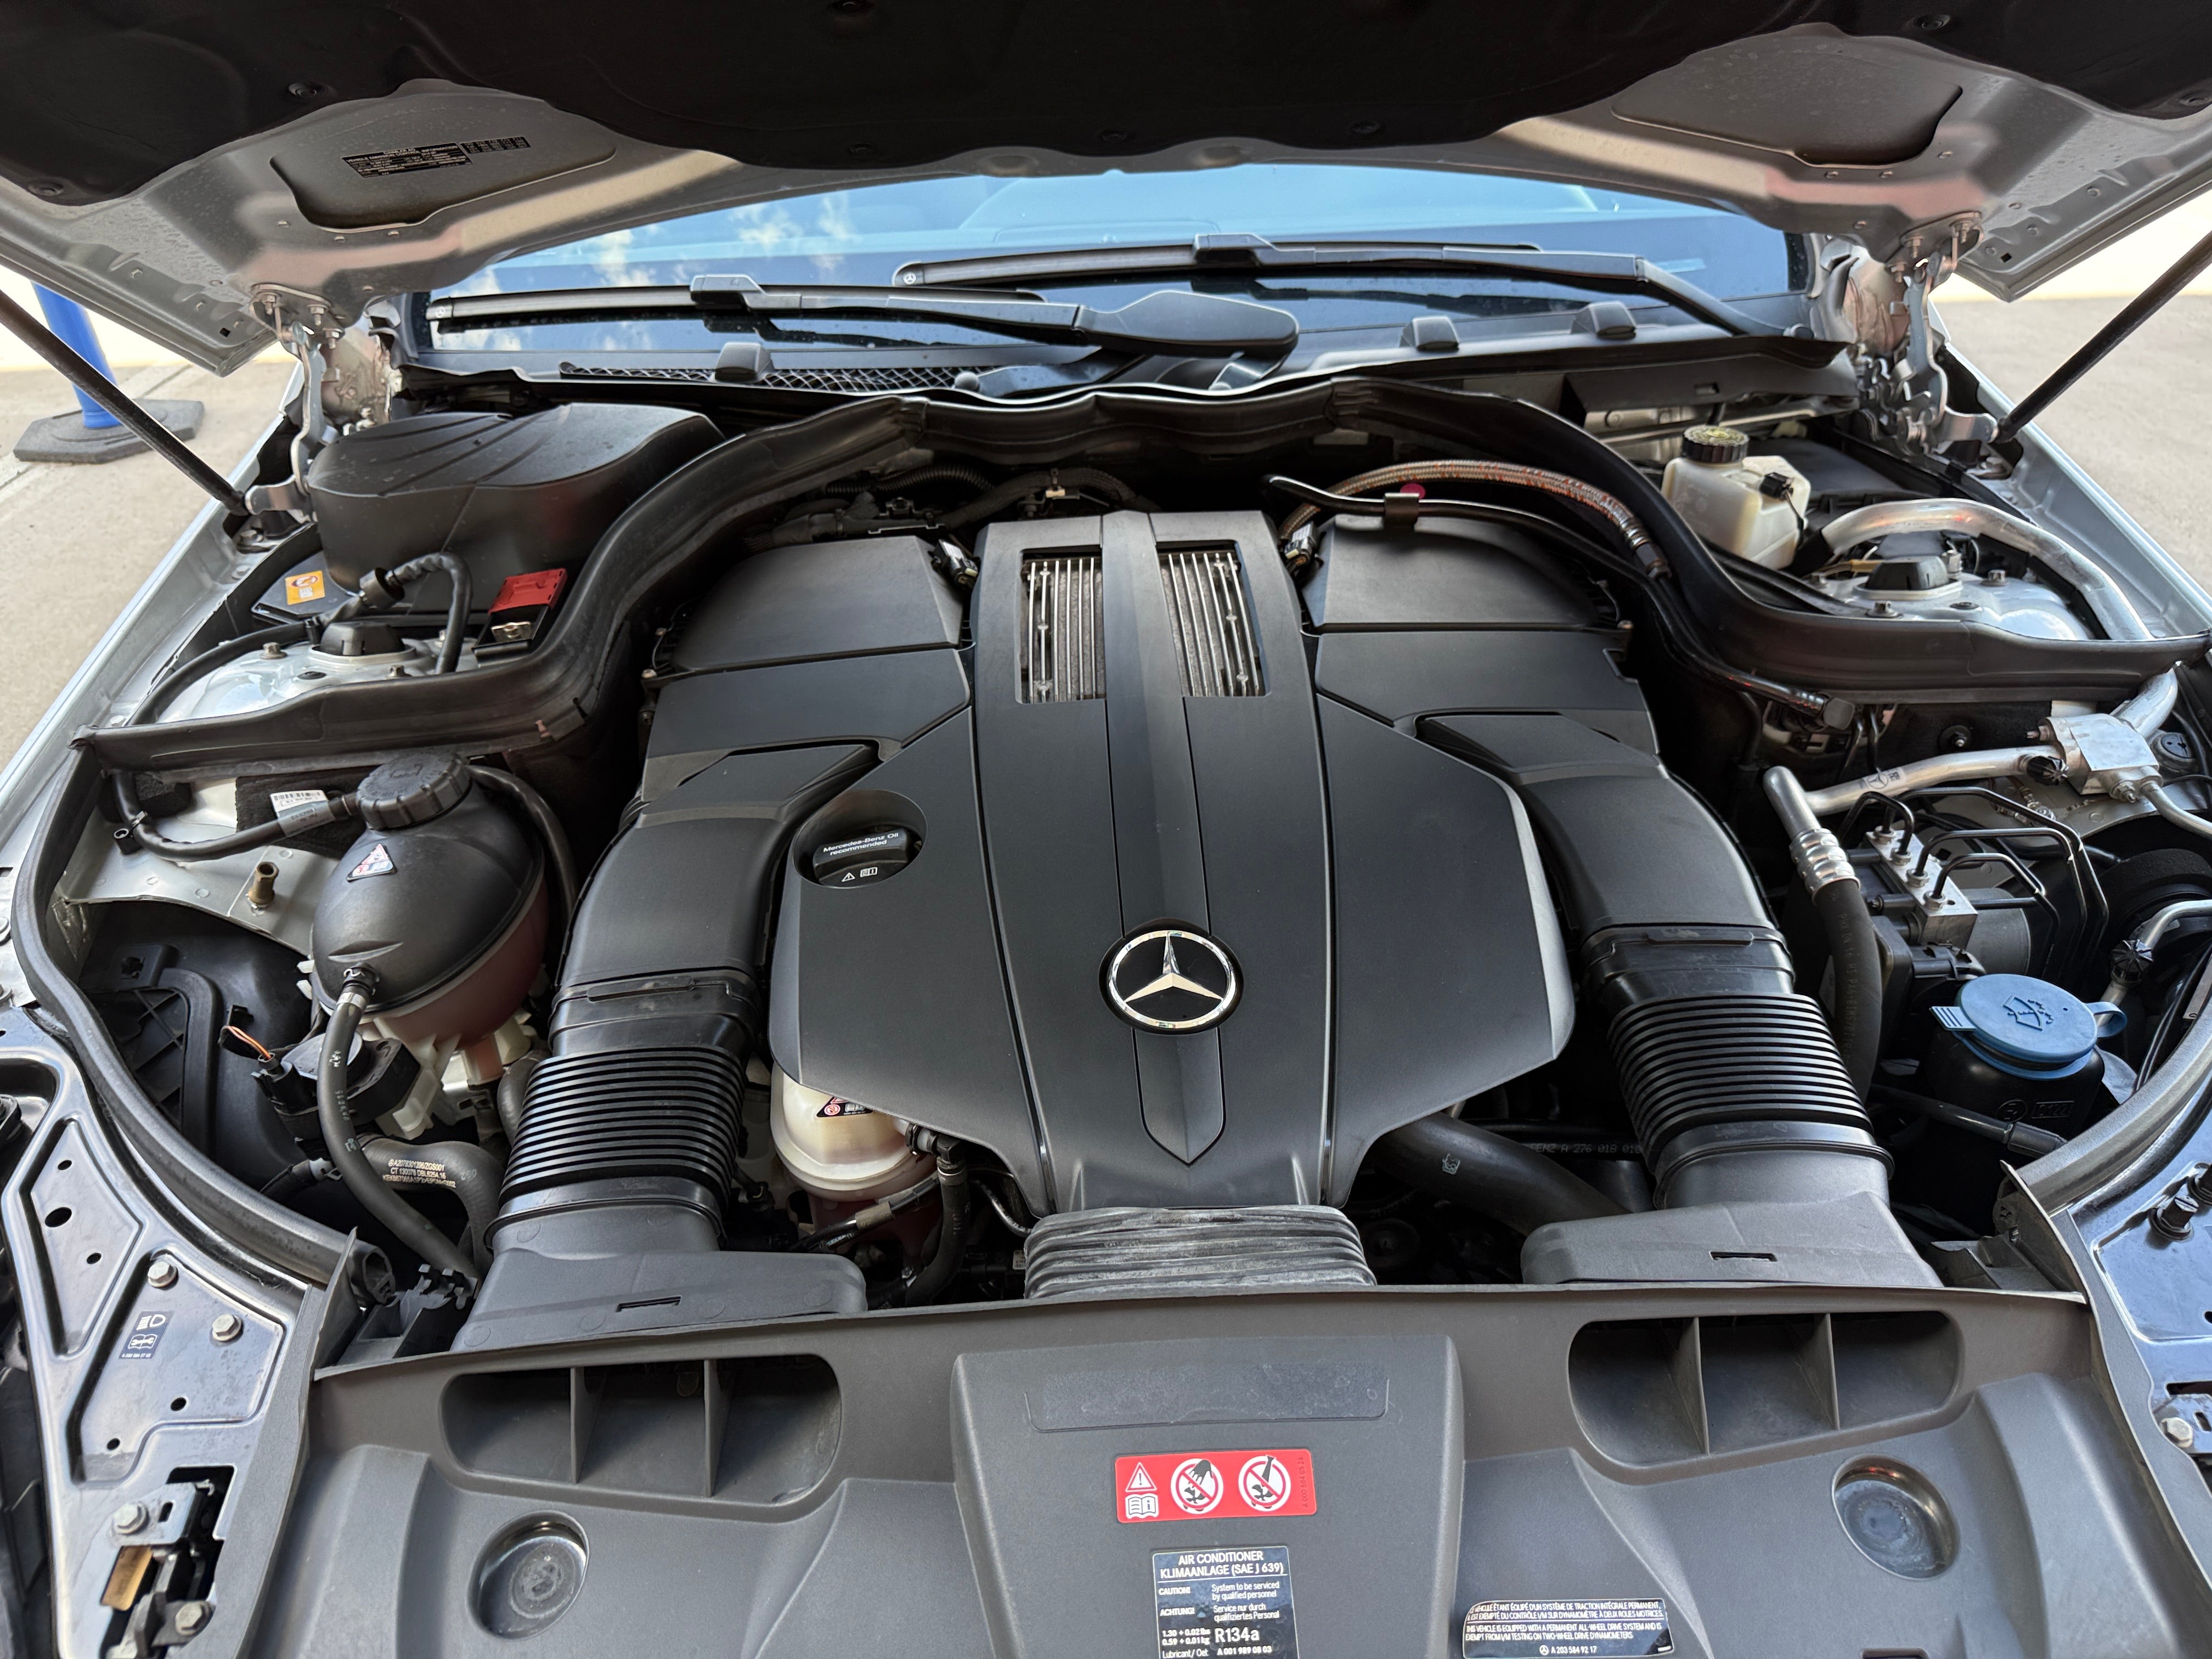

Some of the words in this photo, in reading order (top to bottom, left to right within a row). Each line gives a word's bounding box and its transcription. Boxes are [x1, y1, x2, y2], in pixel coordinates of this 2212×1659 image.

[823, 836, 885, 853] Mercedes-Benz
[830, 839, 887, 856] recommended
[1561, 1144, 1568, 1153] A
[1573, 1144, 1592, 1153] 276
[1178, 1555, 1195, 1565] AIR
[1197, 1550, 1264, 1564] CONDITIONER
[1160, 1565, 1229, 1578] KLIMAANLAGE
[1232, 1563, 1254, 1576] (SAE
[1255, 1563, 1260, 1574] J
[1262, 1562, 1284, 1575] 639)
[1159, 1586, 1190, 1595] CAUTION!
[1211, 1583, 1235, 1593] System
[1244, 1582, 1252, 1590] be
[1254, 1581, 1280, 1589] serviced
[1212, 1593, 1220, 1601] by
[1222, 1591, 1246, 1601] qualified
[1248, 1589, 1277, 1600] personnel
[1160, 1607, 1195, 1616] ACHTUNG!
[1213, 1605, 1237, 1613] Service
[1249, 1603, 1266, 1611] durch
[1493, 1602, 1510, 1612] ÉTANT
[1566, 1602, 1575, 1611] DE
[1574, 1602, 1601, 1610] TRACTION
[1214, 1613, 1253, 1623] qualifiziertes
[1253, 1610, 1280, 1619] Personal
[1500, 1612, 1509, 1620] DU
[1509, 1611, 1537, 1620] CONTRÔLE
[1618, 1610, 1637, 1618] ROUES
[1476, 1624, 1497, 1633] VEHICLE
[1502, 1624, 1527, 1632] EQUIPPED
[1527, 1624, 1542, 1632] WITH
[1547, 1623, 1577, 1632] PERMANENT
[1623, 1622, 1645, 1630] SYSTEM
[1656, 1622, 1662, 1630] IS
[1215, 1627, 1260, 1643] R134a
[1465, 1633, 1485, 1641] EXEMPT
[1485, 1633, 1501, 1641] FROM
[1511, 1632, 1533, 1641] TESTING
[1533, 1632, 1542, 1640] ON
[1542, 1632, 1575, 1640] TWO-WHEEL
[1574, 1632, 1590, 1640] DRIVE
[1238, 1646, 1251, 1655] 989
[1551, 1646, 1556, 1654] A
[1556, 1646, 1568, 1654] 203
[1568, 1645, 1580, 1654] 584
[1581, 1645, 1589, 1654] 92
